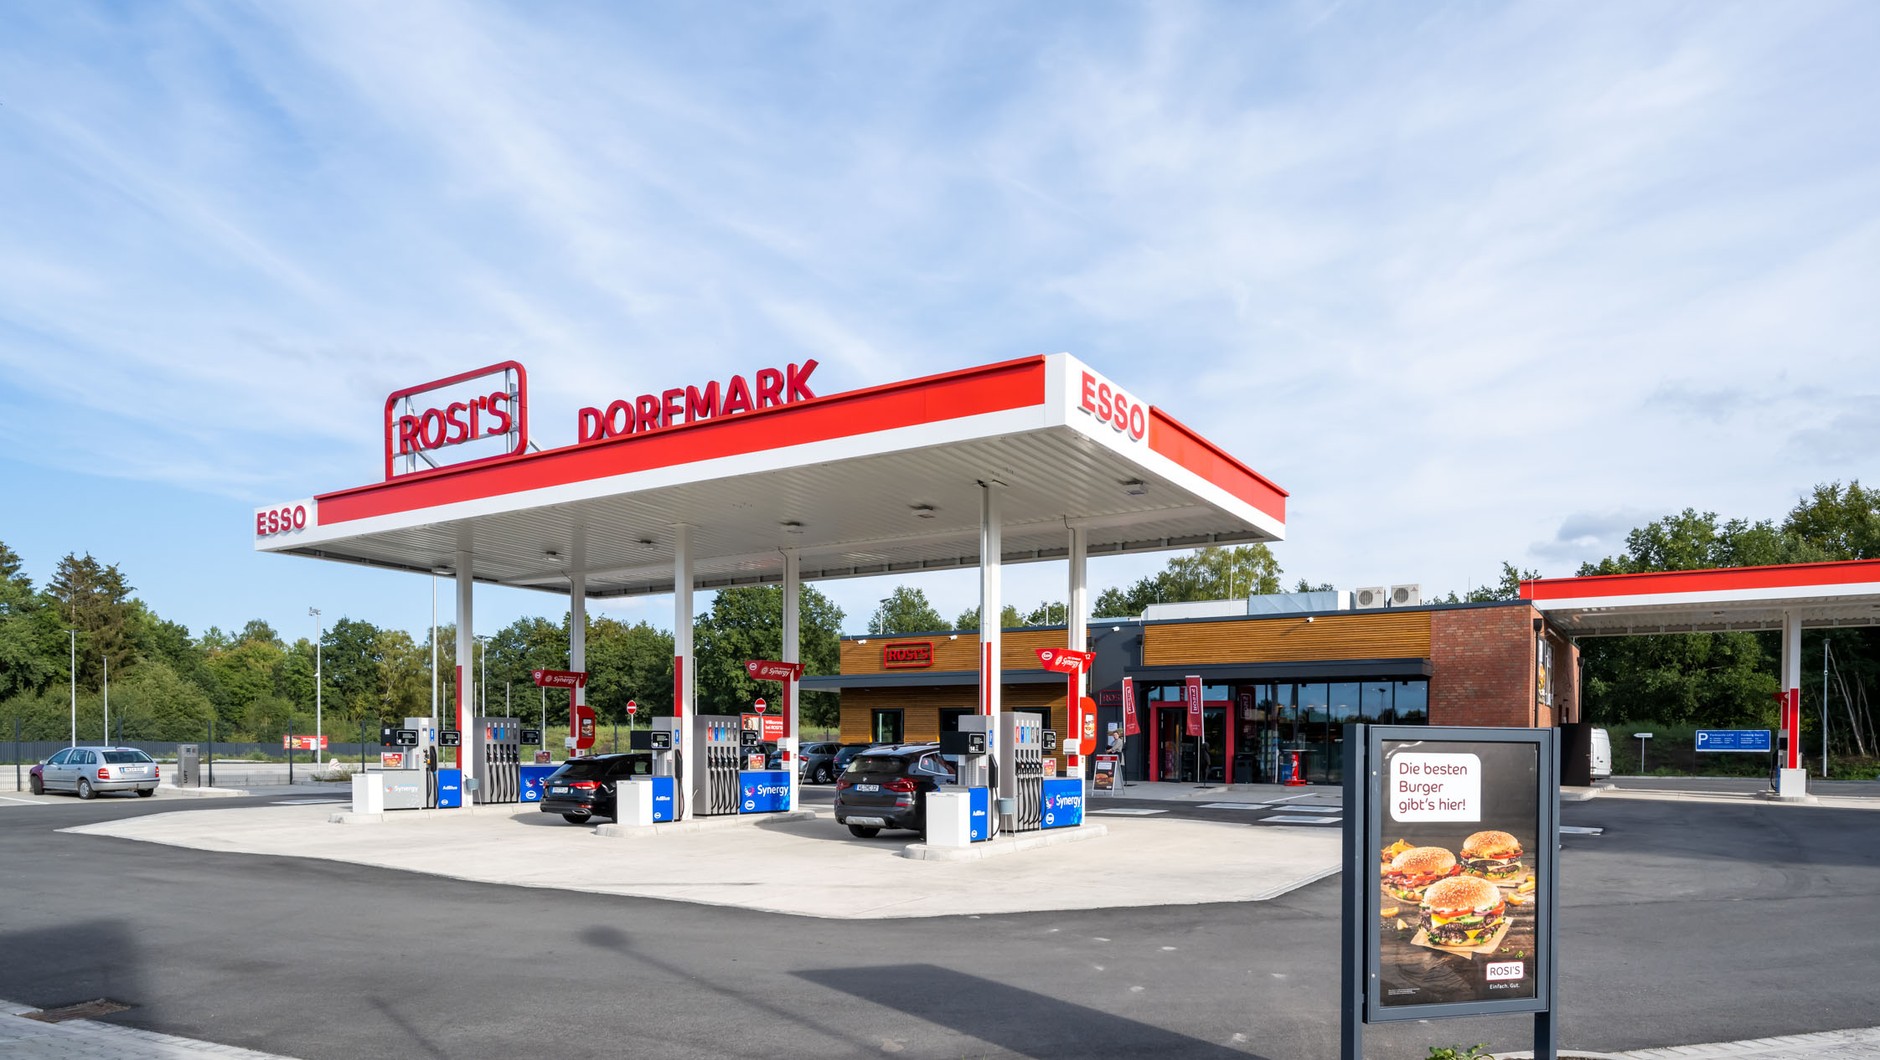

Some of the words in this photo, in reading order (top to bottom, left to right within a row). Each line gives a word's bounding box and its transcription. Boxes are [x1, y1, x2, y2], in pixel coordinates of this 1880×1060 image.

[578, 359, 819, 443] DORFMARK
[1081, 370, 1145, 440] ESSO
[399, 391, 512, 455] ROSI'S
[256, 505, 306, 536] ESSO
[889, 648, 929, 661] ROSI'S
[1698, 732, 1708, 746] P
[1399, 762, 1420, 775] Die
[1424, 762, 1467, 775] besten
[757, 784, 789, 797] Synergy
[1399, 780, 1444, 796] Burger
[1056, 794, 1082, 809] Synergy
[1399, 798, 1435, 814] gibt's
[1439, 798, 1466, 811] hier!
[1490, 966, 1521, 976] ROSI'S
